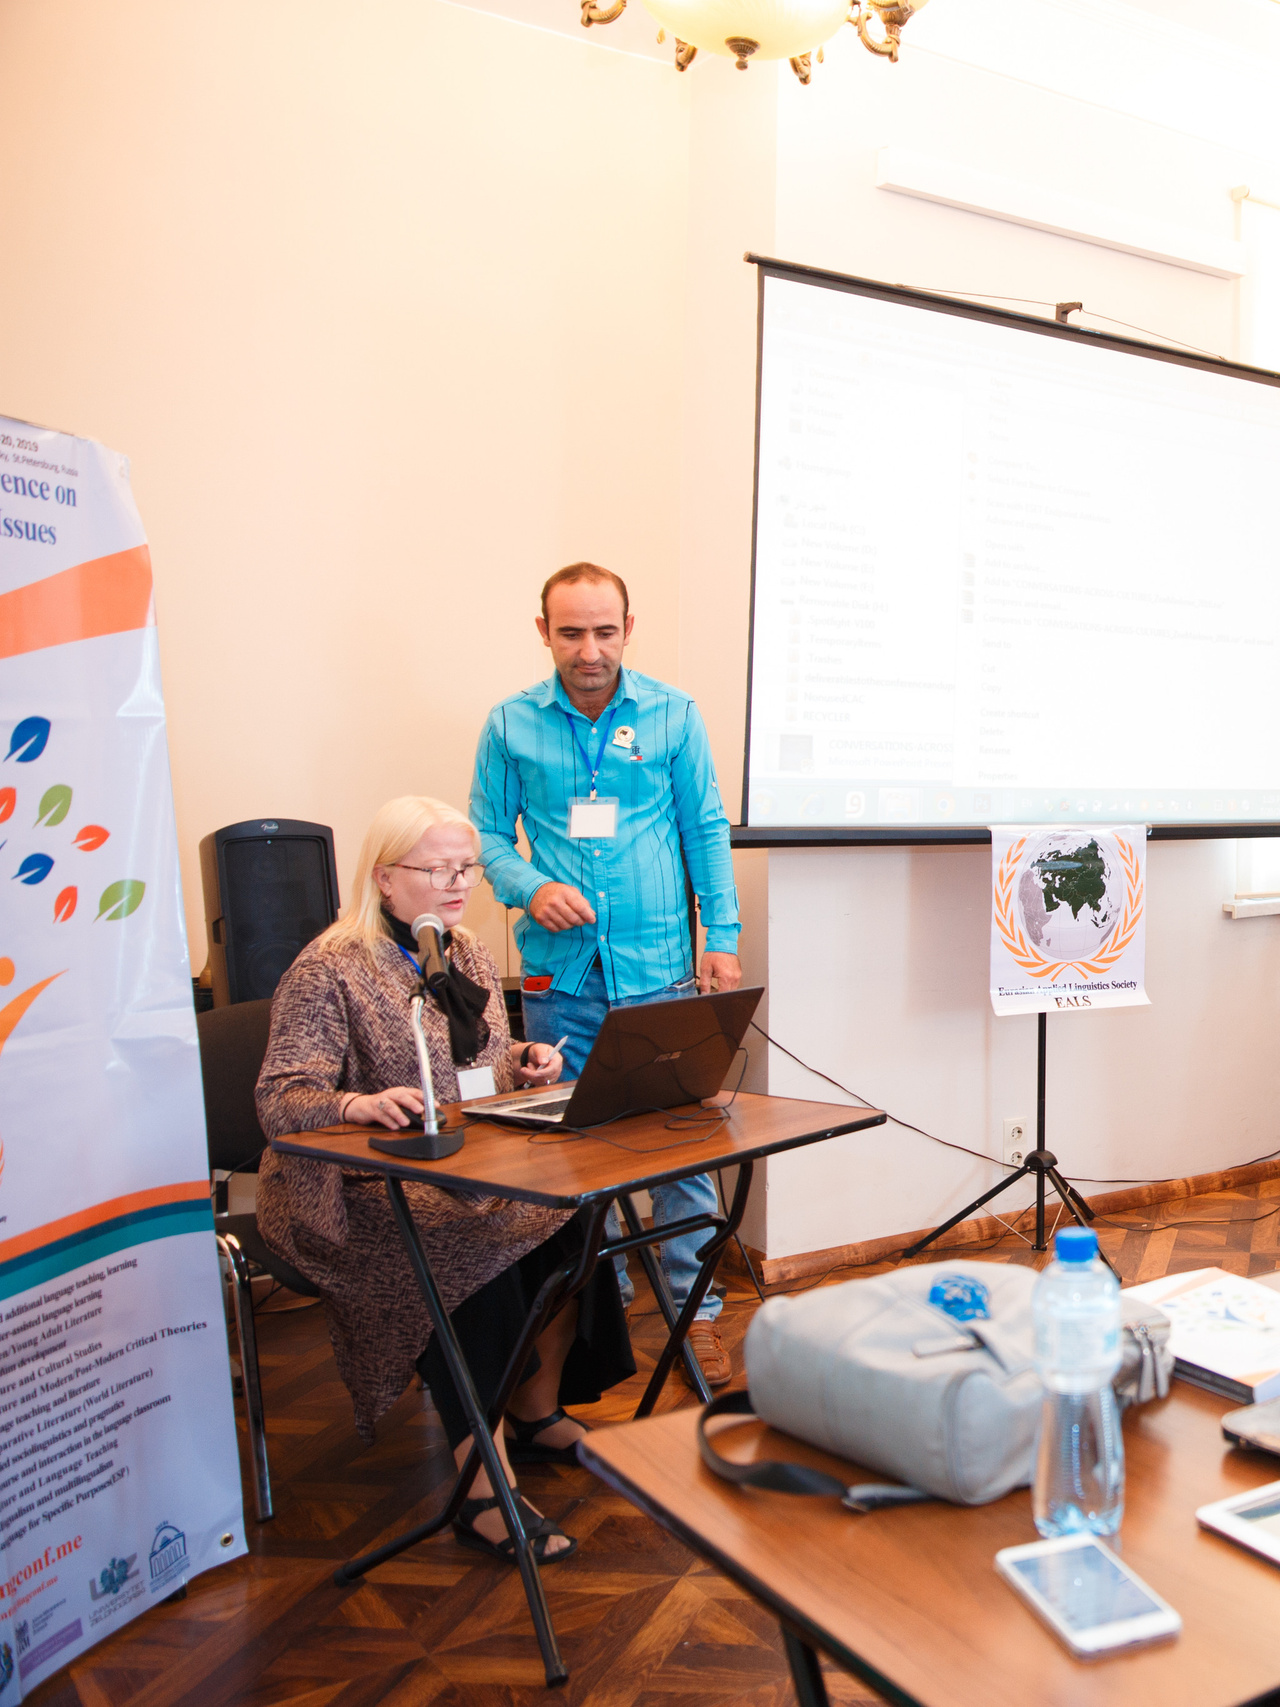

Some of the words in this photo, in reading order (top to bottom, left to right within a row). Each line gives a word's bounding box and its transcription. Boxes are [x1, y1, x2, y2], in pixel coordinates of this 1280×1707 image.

[0, 471, 51, 501] ence
[55, 485, 77, 507] on
[1069, 981, 1110, 993] Linguistics
[1111, 979, 1138, 991] Society
[1054, 996, 1093, 1009] EALS
[159, 1320, 208, 1340] Theories
